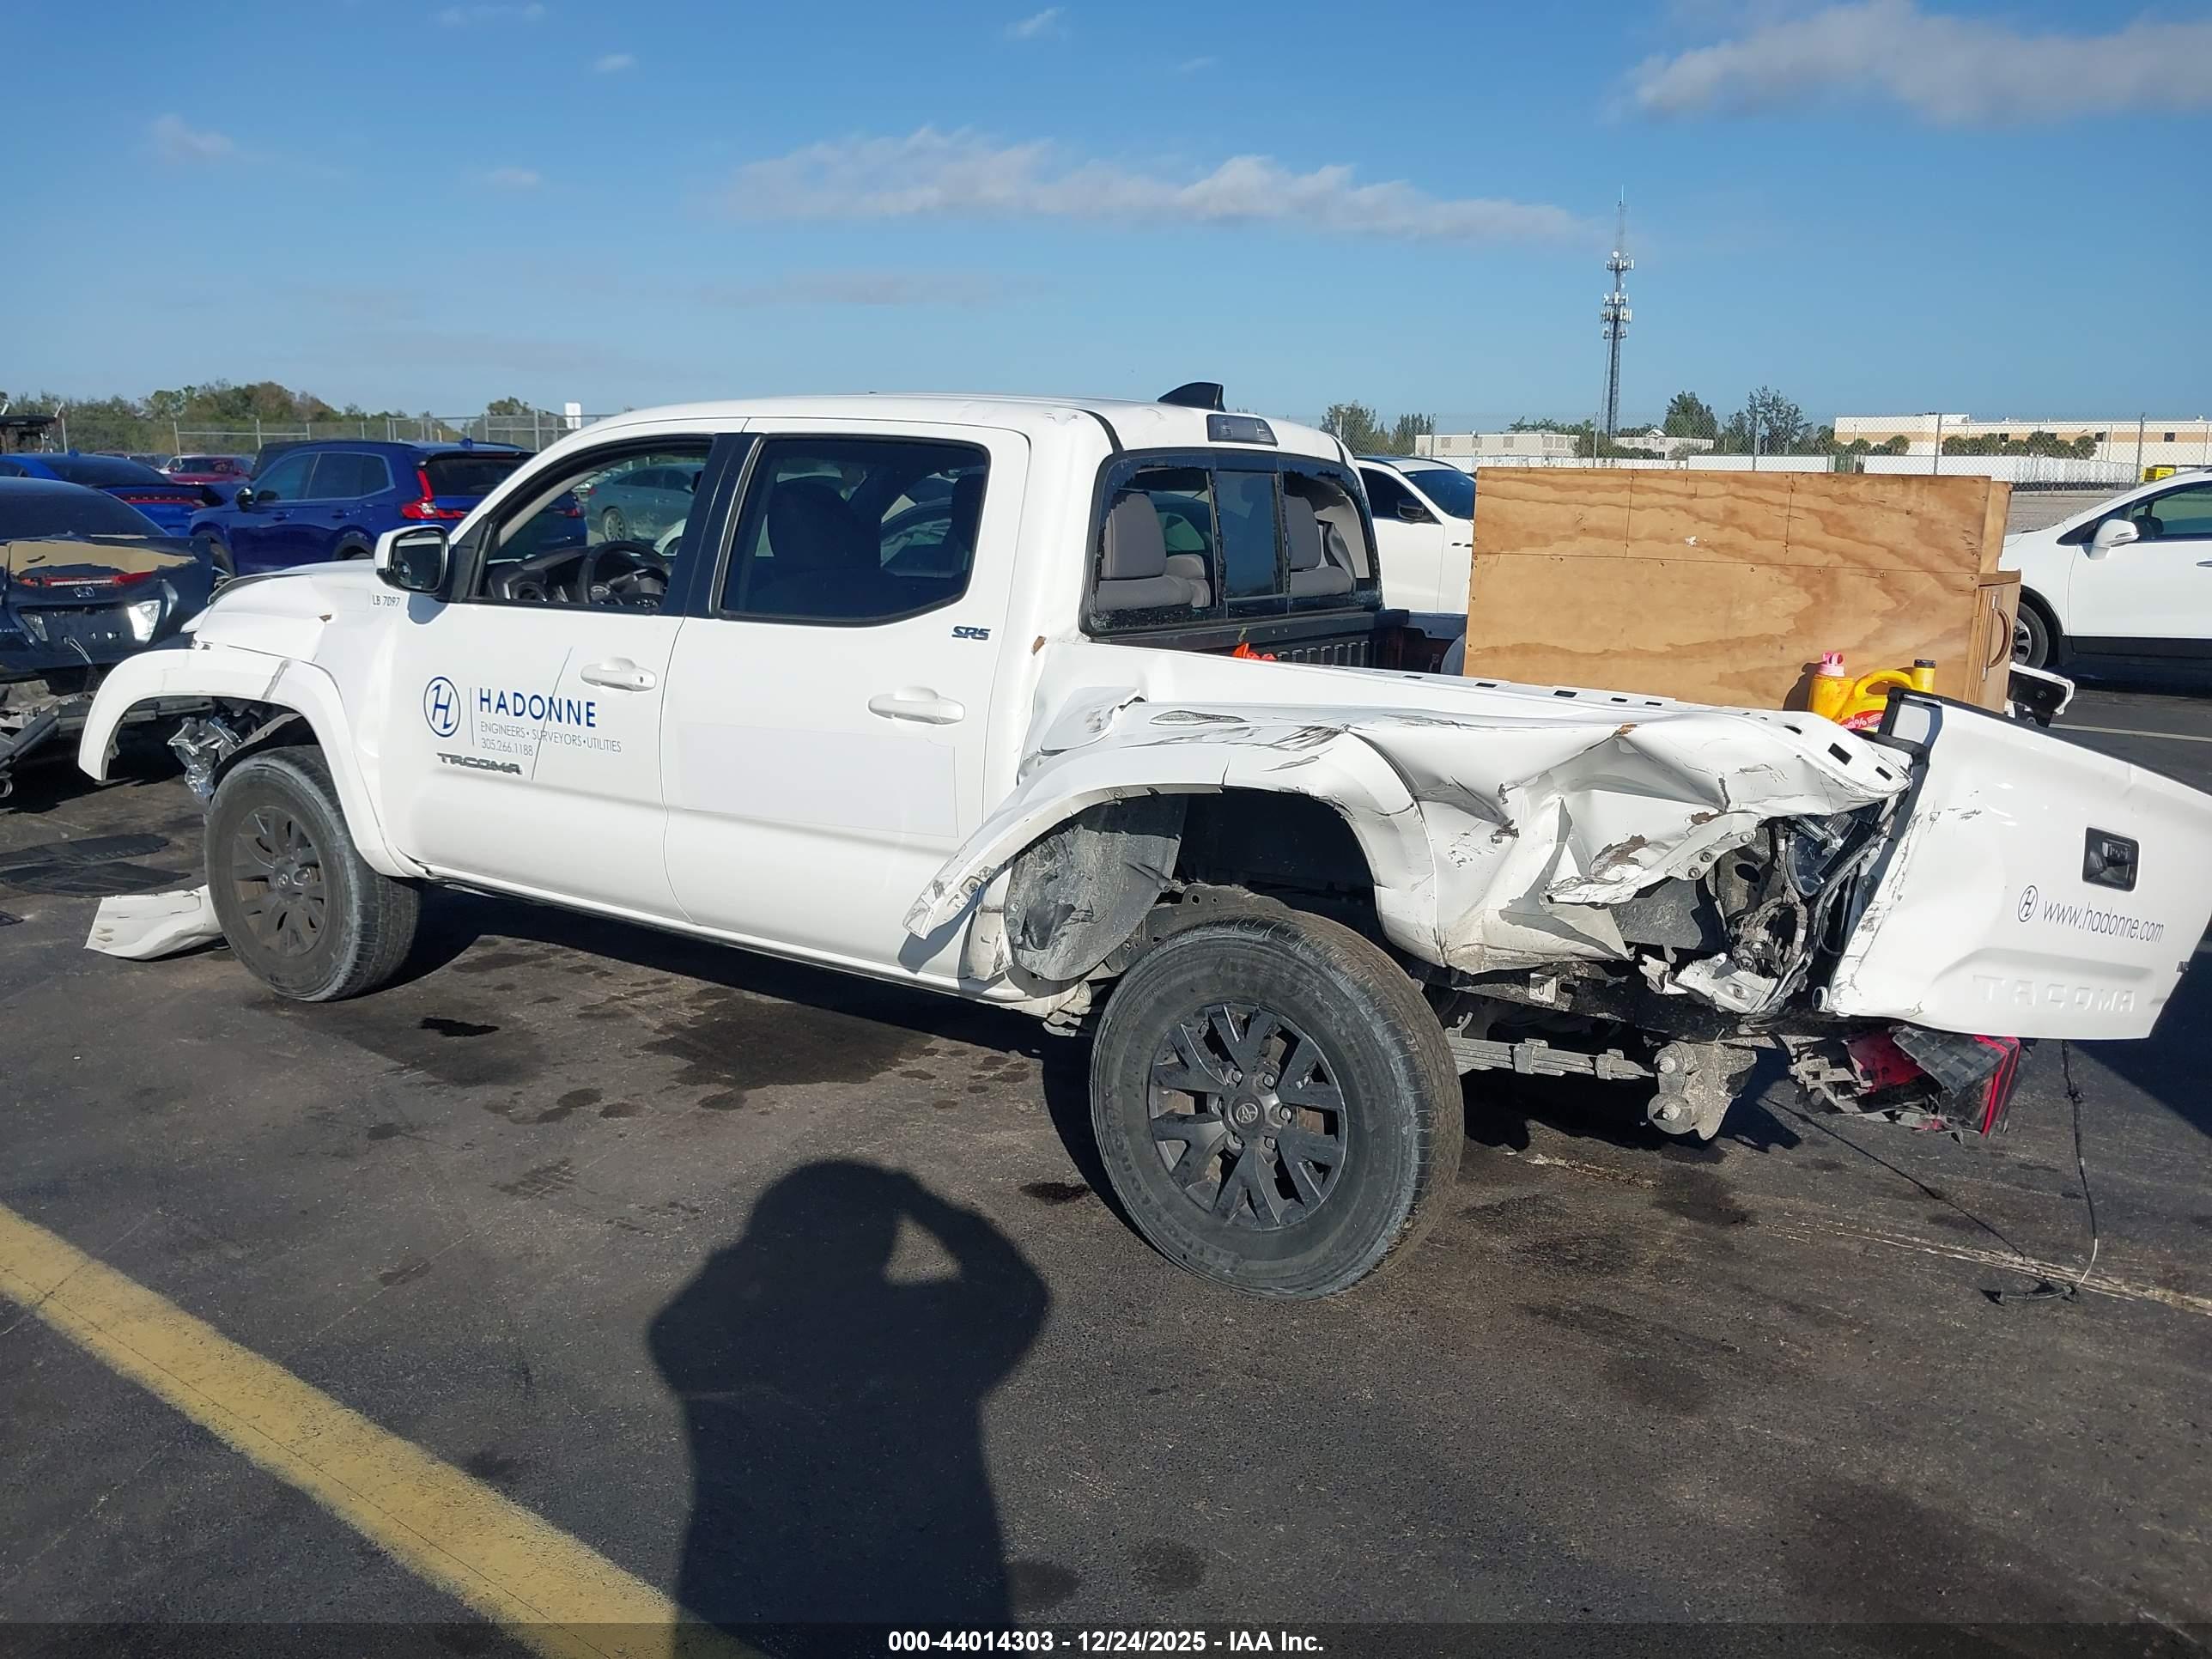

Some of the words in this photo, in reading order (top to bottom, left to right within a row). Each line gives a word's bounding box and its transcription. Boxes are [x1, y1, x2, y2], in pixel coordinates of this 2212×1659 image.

[371, 594, 381, 605] LB
[478, 687, 597, 728] HADONNE
[480, 720, 526, 738] ENGINEERS
[532, 728, 582, 747] SURVEYORS
[586, 737, 623, 753] UTILITIES
[481, 737, 534, 757] 305.266.1188
[436, 751, 523, 775] TACOMA
[2043, 900, 2165, 944] www.hadonne.com
[1972, 974, 2136, 1013] TACOMA
